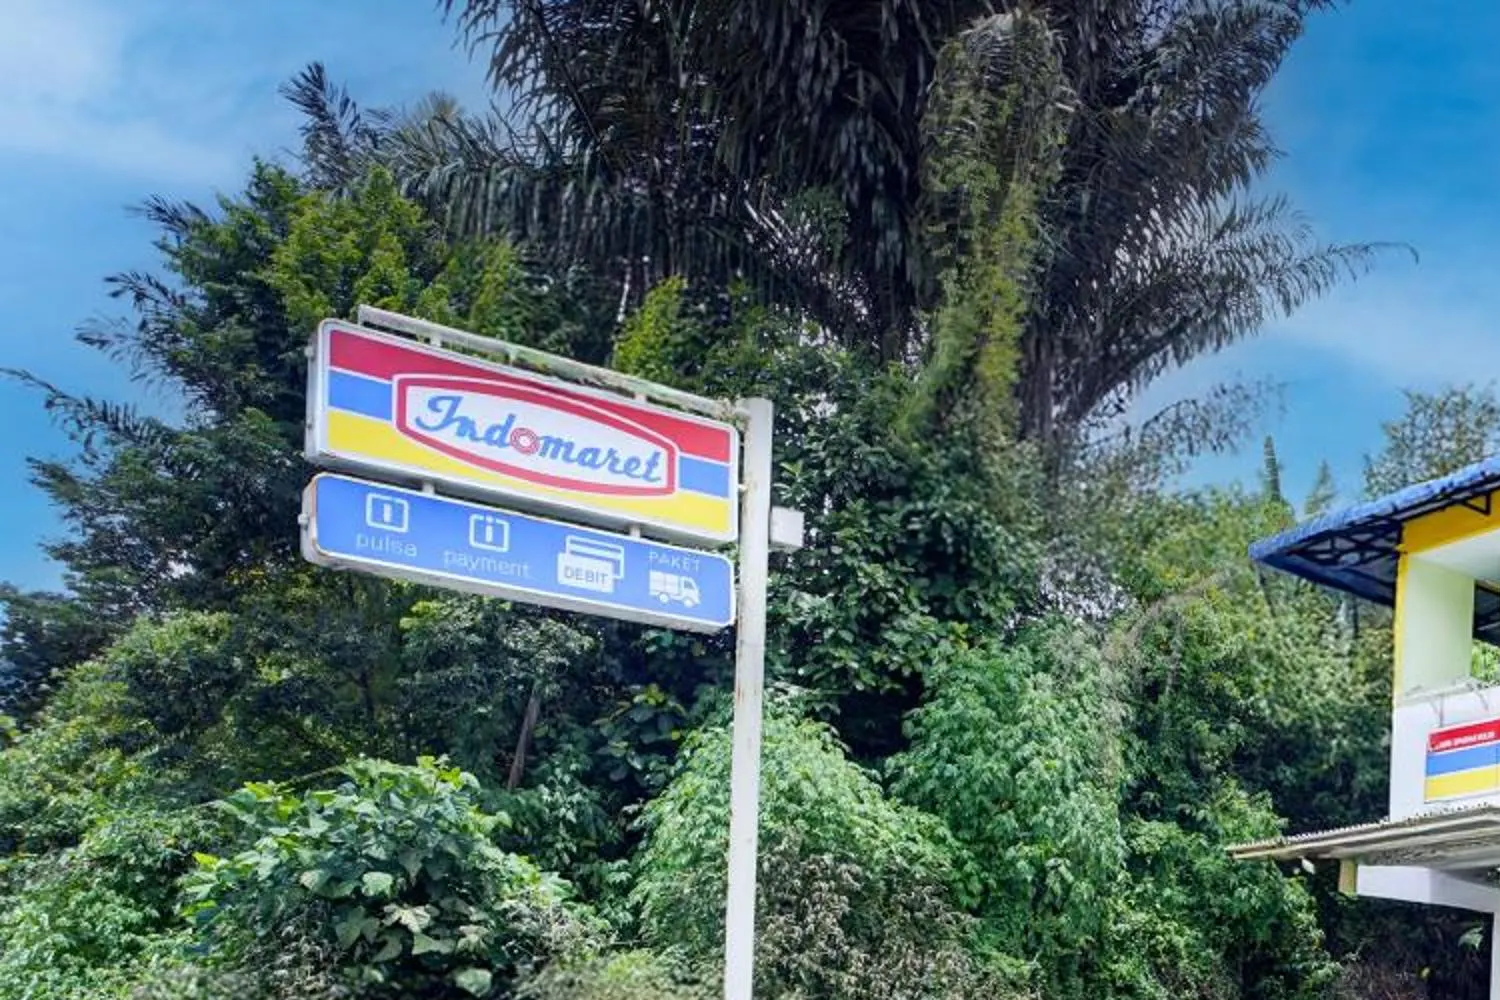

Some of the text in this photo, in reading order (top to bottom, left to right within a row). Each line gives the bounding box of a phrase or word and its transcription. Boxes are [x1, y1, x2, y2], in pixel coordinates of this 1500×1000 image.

[415, 394, 663, 483] Indomaret
[356, 533, 418, 557] pulsa
[443, 549, 531, 577] payment
[648, 551, 700, 573] PAKET
[564, 565, 609, 585] DEBIT
